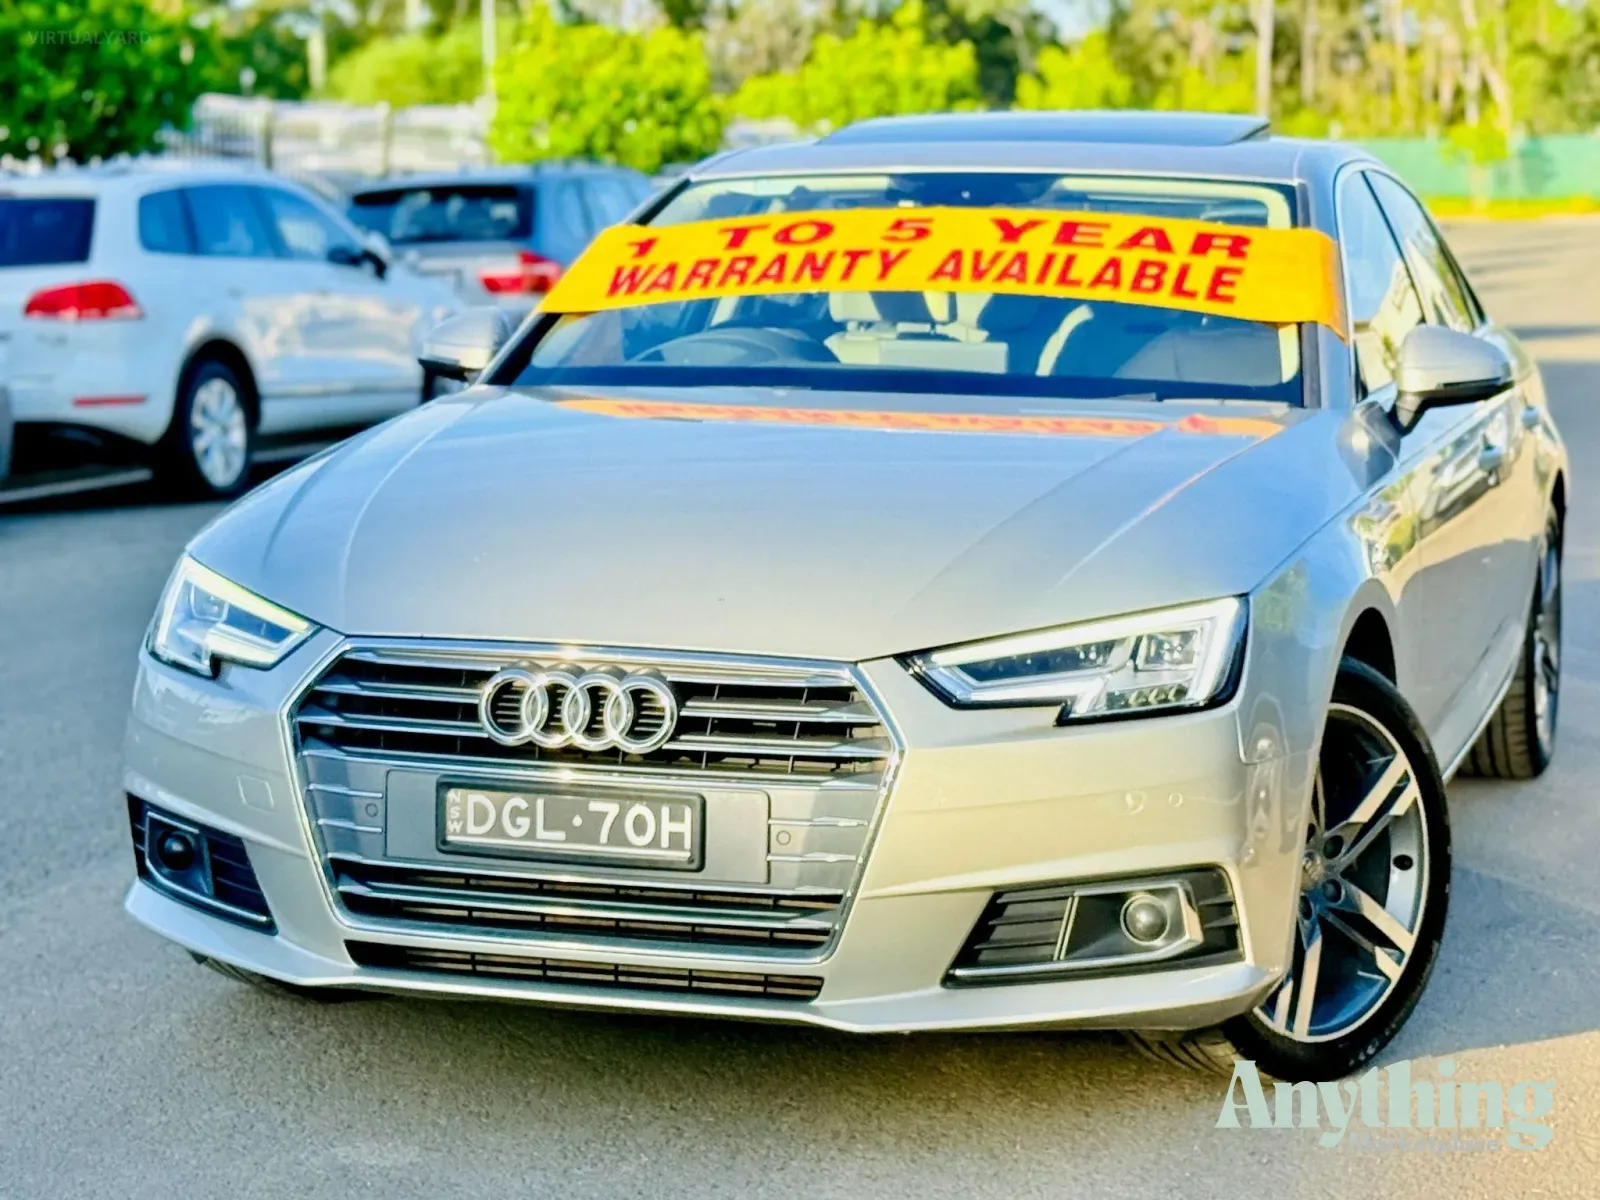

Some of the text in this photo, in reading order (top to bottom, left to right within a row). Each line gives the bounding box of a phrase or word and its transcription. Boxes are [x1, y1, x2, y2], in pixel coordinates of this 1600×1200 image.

[627, 217, 1253, 261] 1 TO 5 YEAR
[605, 248, 1246, 304] WARRANTY AVAILABLE
